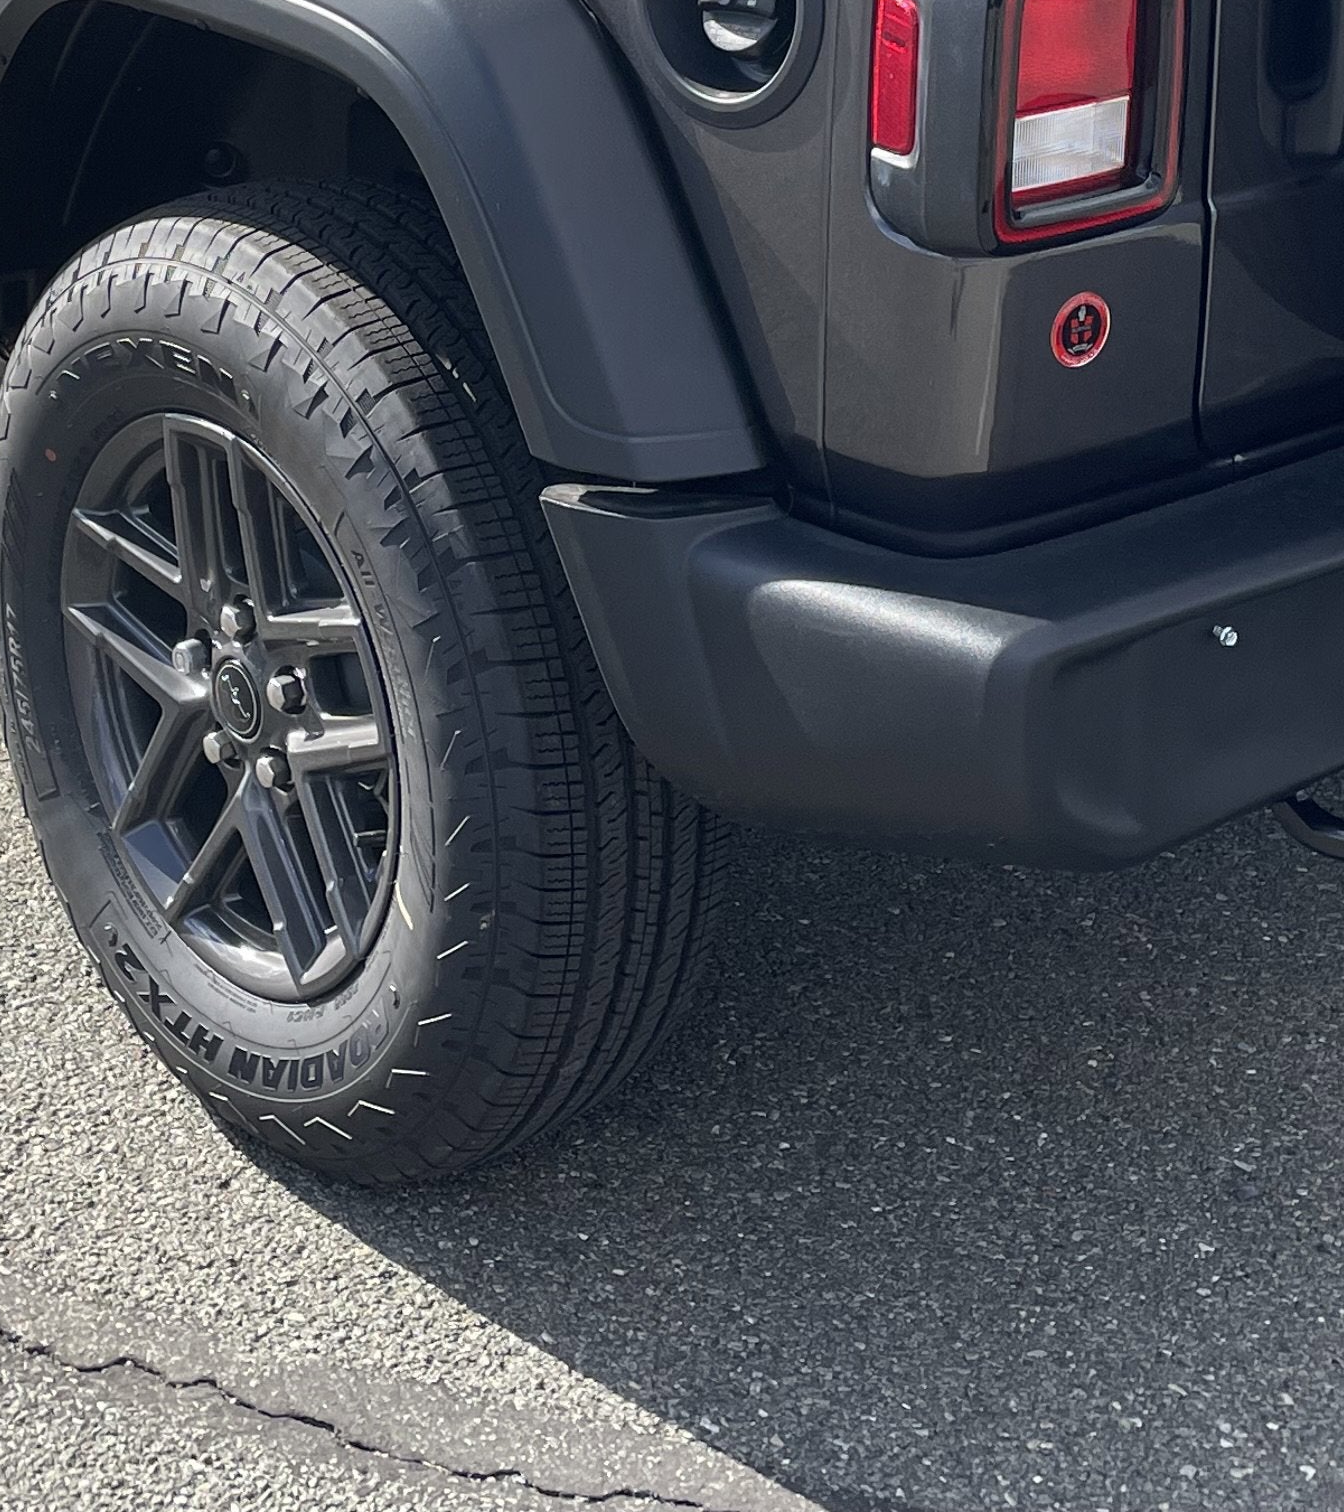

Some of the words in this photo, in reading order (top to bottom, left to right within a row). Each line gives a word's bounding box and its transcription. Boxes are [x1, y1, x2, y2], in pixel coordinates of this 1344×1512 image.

[56, 336, 242, 406] NEXEN
[6, 601, 42, 755] 245/75R17
[136, 974, 224, 1063] HTX
[227, 996, 391, 1092] ROADIAN
